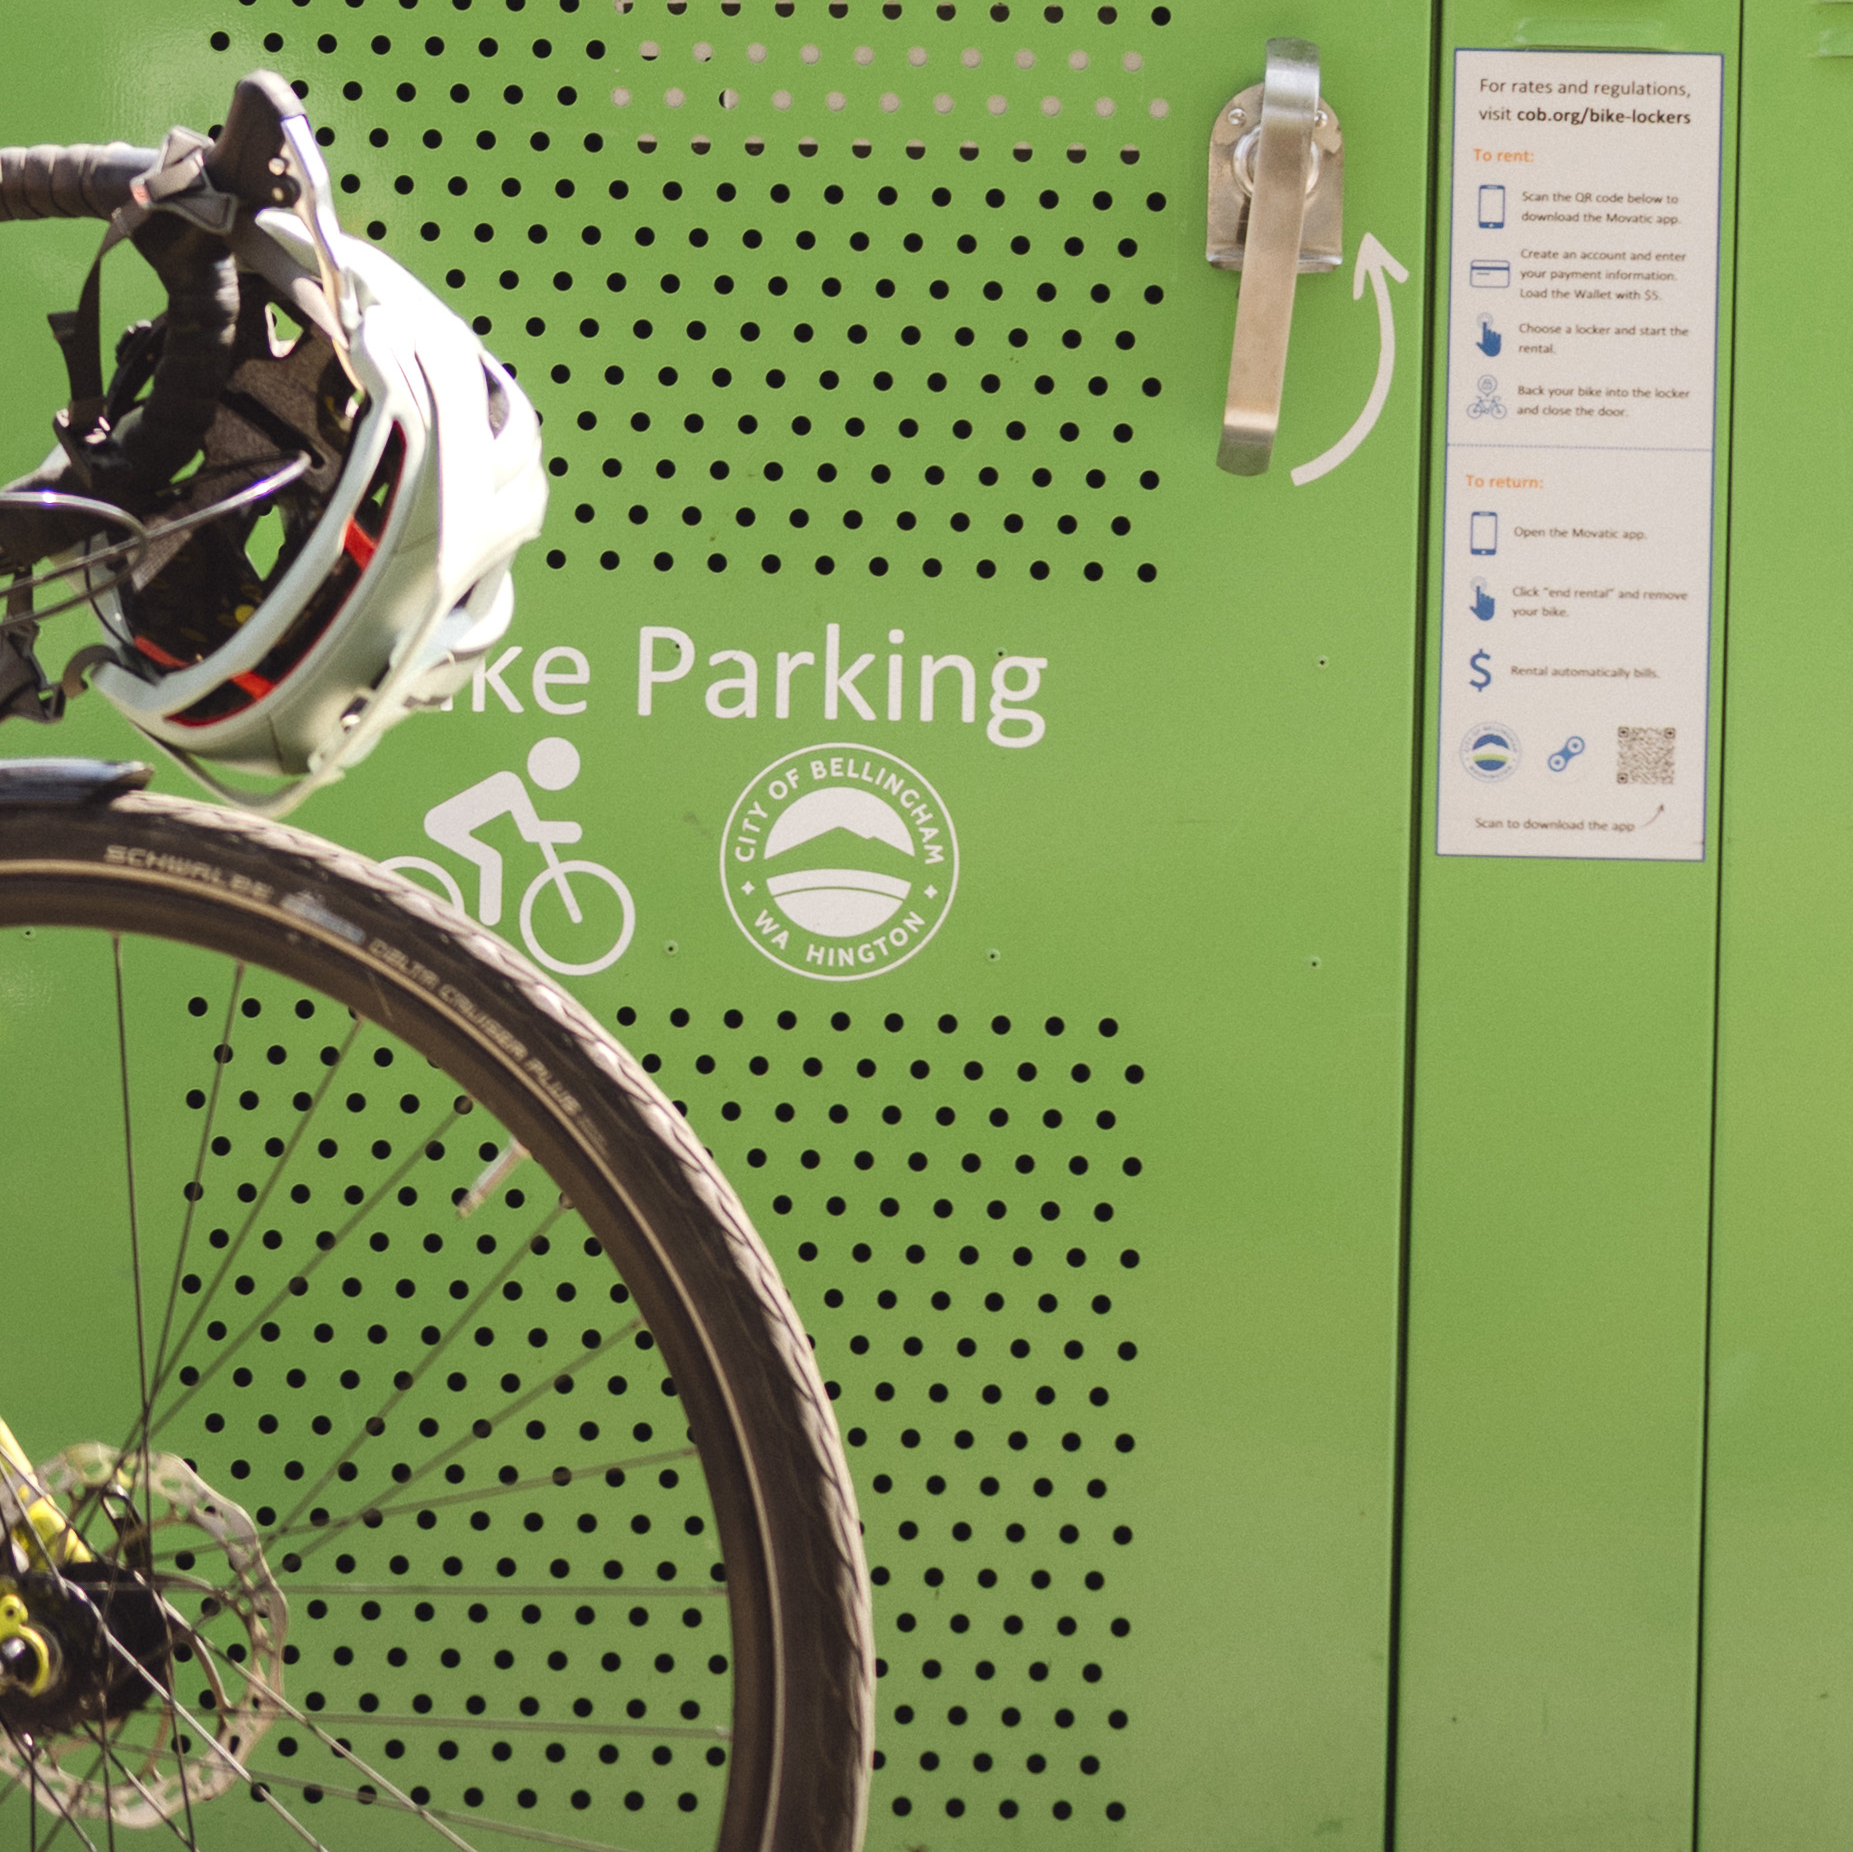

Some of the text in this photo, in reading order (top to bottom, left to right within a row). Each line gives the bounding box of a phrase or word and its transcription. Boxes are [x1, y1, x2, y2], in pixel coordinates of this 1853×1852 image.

[1479, 77, 1691, 100] For rates and regulations,
[1478, 106, 1692, 127] visit cob.org/bike-lockers
[1474, 147, 1535, 163] To rent:
[1522, 190, 1679, 204] Scan the QR code below to
[1520, 211, 1682, 226] download the Movatic app.
[1519, 248, 1687, 262] Create an account and enter
[1519, 269, 1678, 282] your payment information.
[1520, 287, 1662, 302] Load the Wallet with $5.
[1517, 322, 1690, 337] Choose a locker and start the
[1517, 343, 1556, 355] rental.
[1517, 385, 1689, 399] Back your bike into the locker
[1516, 404, 1628, 417] and close the door.
[1465, 474, 1544, 490] To return:
[1513, 526, 1648, 541] Open the Movatic app.
[1511, 585, 1689, 601] Click "end rental" and remove
[1511, 606, 1569, 619] your bike.
[1509, 665, 1660, 680] Rental automatically bills.
[637, 623, 1049, 750] Parking
[735, 757, 945, 866] CITY OF BELLINGHAM
[1474, 817, 1636, 834] Scan to download the app
[103, 844, 276, 904] SCHWALBE
[438, 984, 529, 1062] CRUISER
[524, 1058, 583, 1118] PLUS
